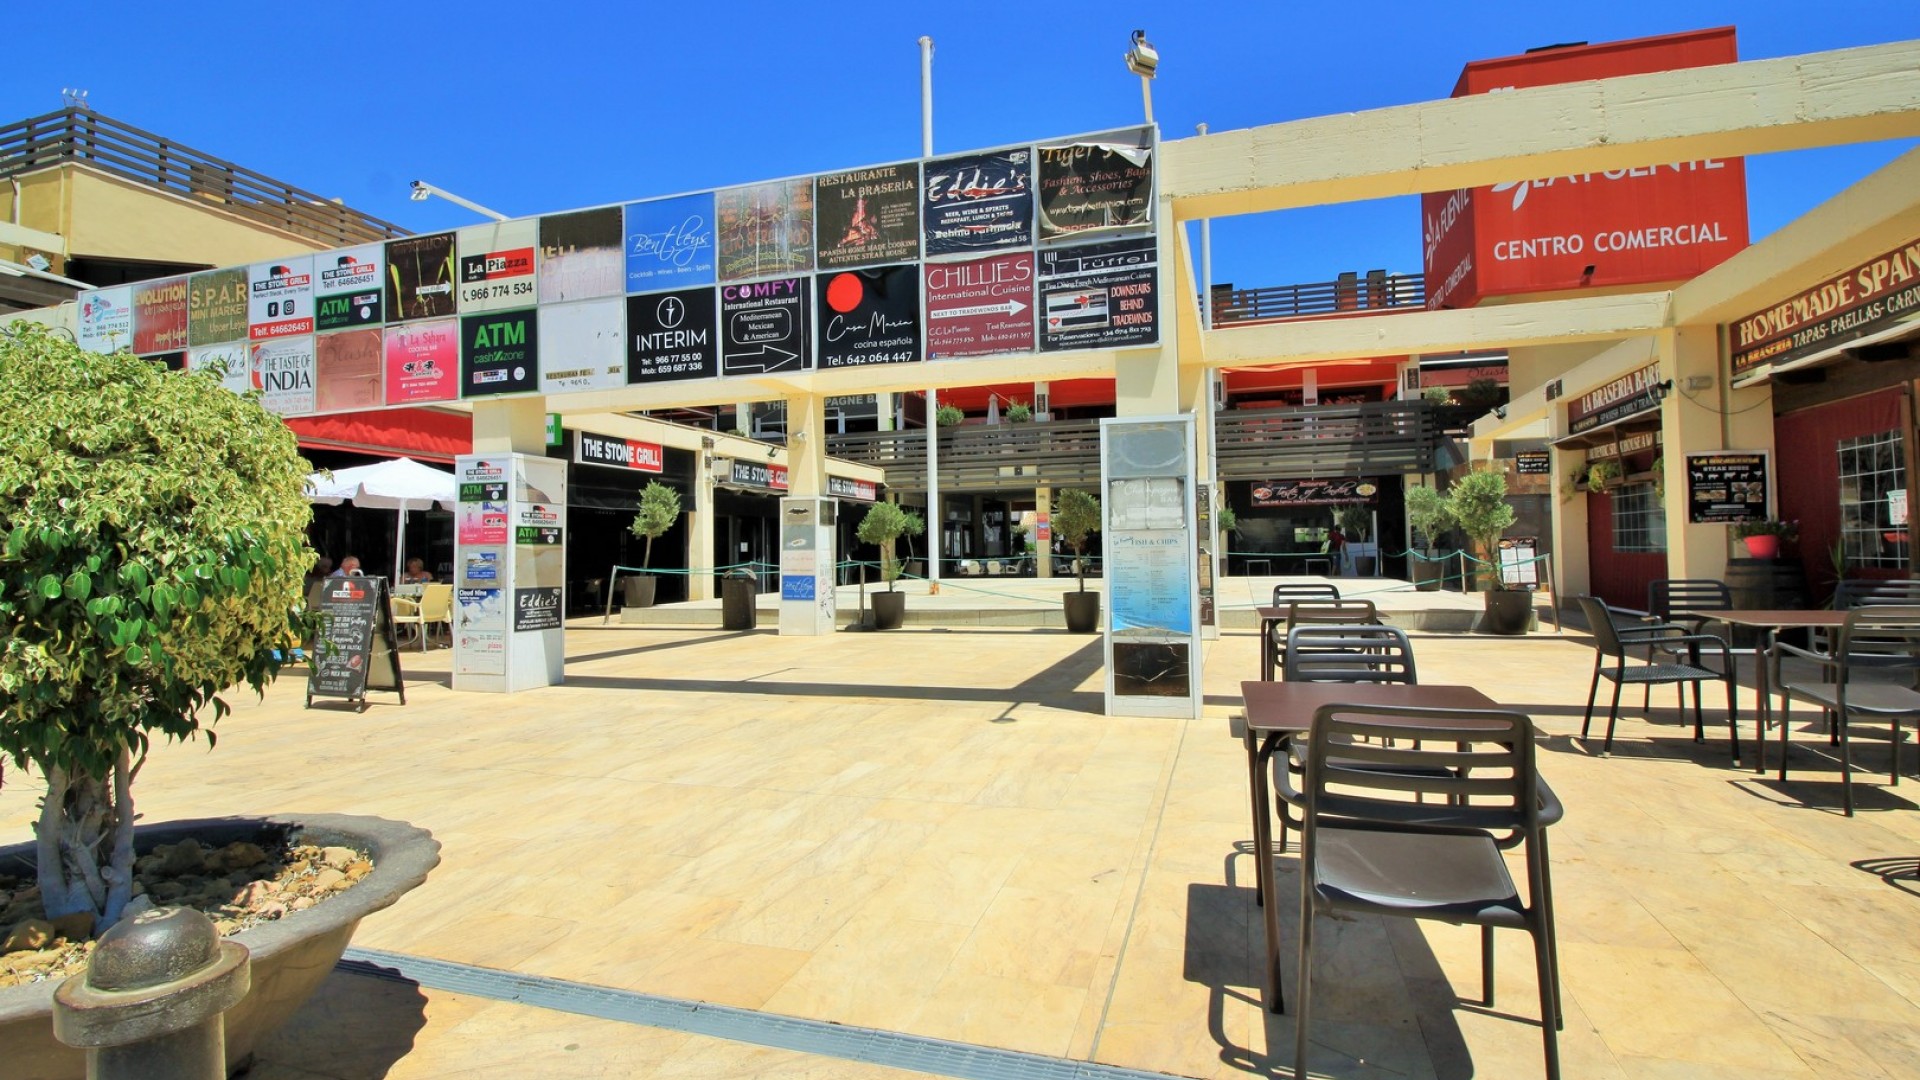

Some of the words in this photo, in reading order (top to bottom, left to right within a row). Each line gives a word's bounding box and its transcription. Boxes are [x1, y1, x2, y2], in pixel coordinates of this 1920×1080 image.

[820, 168, 896, 187] RESTAURANTE
[928, 168, 1026, 202] Eddie's
[841, 188, 856, 199] LA
[858, 180, 914, 198] BRASERIA
[1494, 234, 1583, 260] CENTRO
[1594, 222, 1728, 252] COMERCIAL
[324, 271, 335, 279] THE
[336, 268, 355, 277] STONE
[468, 262, 484, 274] La
[487, 258, 528, 272] Piazza
[629, 271, 654, 280] Cocktails
[928, 260, 1031, 290] CHILLIES
[255, 282, 268, 291] THE
[268, 280, 288, 288] STONE
[290, 276, 308, 286] GRILL
[471, 288, 488, 300] 966
[492, 285, 510, 298] 774
[514, 282, 532, 294] 534
[724, 280, 797, 300] COMFY
[1110, 282, 1152, 298] DOWNSTAIRS
[928, 286, 989, 302] International
[991, 284, 1031, 296] Cuisine
[1740, 276, 1855, 347] HOMEMADE
[1858, 242, 1920, 298] SPAN
[320, 298, 350, 316] ATM
[724, 299, 763, 311] International
[765, 296, 798, 306] Restaurant
[1120, 298, 1144, 311] BEHIND
[191, 309, 208, 320] MINI
[210, 304, 247, 318] MARKET
[740, 312, 782, 322] Mediterranean
[1112, 312, 1152, 326] TRADEWINDS
[254, 326, 269, 337] Telf.
[270, 322, 310, 334] 646626451
[474, 320, 525, 348] ATM
[748, 322, 774, 331] Mexican
[826, 314, 867, 342] Casa
[1736, 356, 1746, 368] LA
[1886, 286, 1920, 313] CARN
[636, 328, 706, 352] INTERIM
[750, 332, 780, 340] American
[854, 340, 878, 349] cocina
[879, 336, 912, 348] española
[265, 358, 276, 372] THE
[280, 356, 300, 370] TASTE
[301, 354, 312, 368] OF
[655, 356, 670, 364] 966
[671, 354, 680, 362] 77
[692, 352, 702, 361] 00
[826, 354, 844, 366] Tel.
[846, 354, 866, 365] 642
[869, 352, 890, 362] 064
[892, 352, 912, 362] 447
[641, 368, 656, 376] Mob:
[658, 365, 672, 374] 659
[674, 364, 686, 372] 687
[265, 370, 312, 392] INDIA
[766, 401, 788, 410] THE
[824, 396, 863, 406] PAGNE
[1582, 394, 1592, 414] LA
[1592, 376, 1634, 409] BRASERIA
[584, 438, 602, 458] THE
[605, 442, 634, 462] STONE
[636, 447, 660, 466] GRILL
[735, 464, 750, 479] THE
[752, 466, 774, 484] STONE
[463, 485, 482, 496] ATM
[831, 478, 841, 490] THE
[842, 480, 858, 493] STONE
[860, 483, 872, 496] GRILL
[518, 528, 538, 538] ATM
[520, 594, 558, 608] Eddie's
